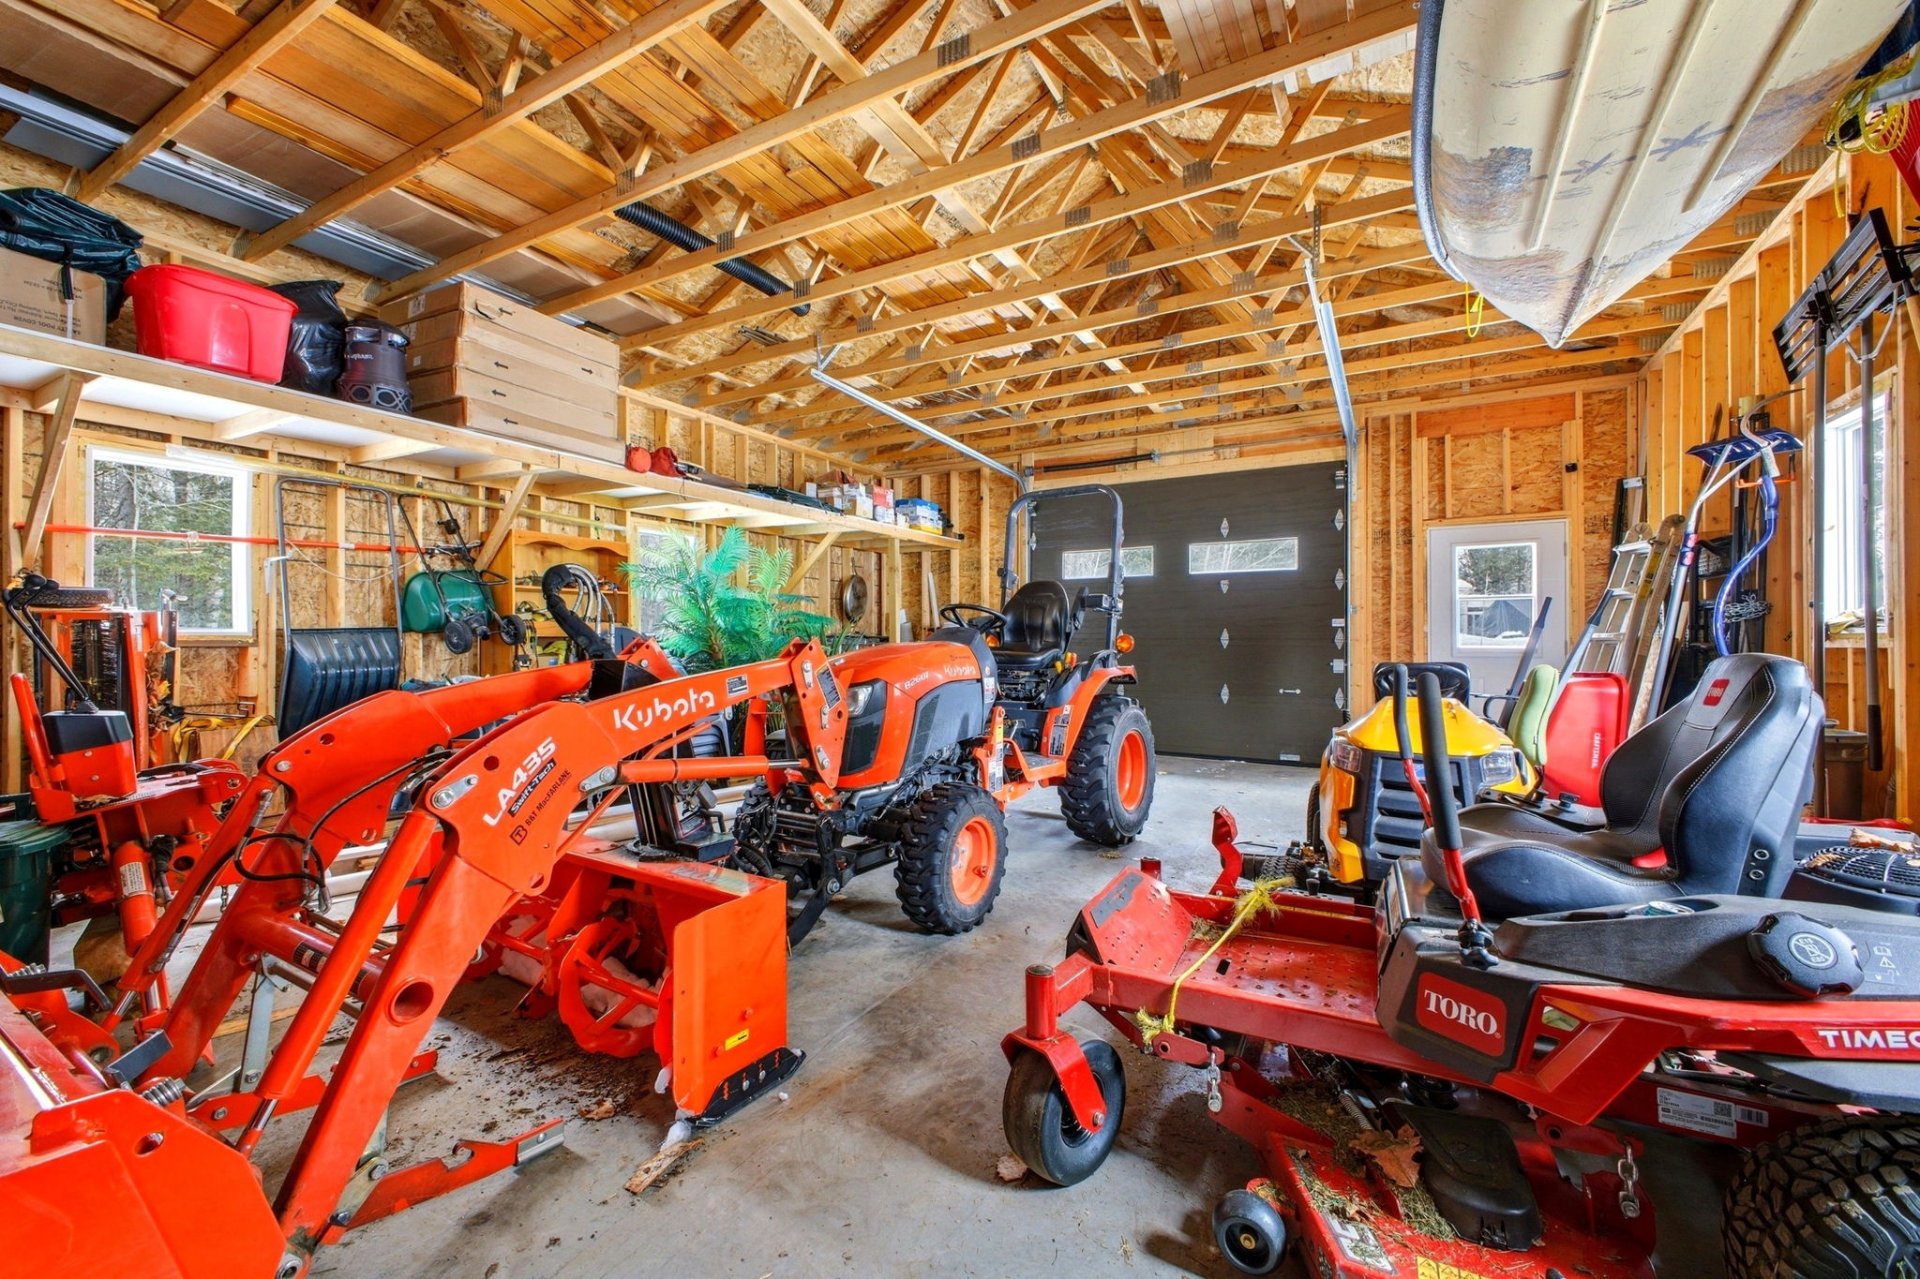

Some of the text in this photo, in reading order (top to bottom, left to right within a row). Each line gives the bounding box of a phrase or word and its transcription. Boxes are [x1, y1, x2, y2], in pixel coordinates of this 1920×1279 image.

[944, 664, 976, 677] Kubota
[613, 688, 715, 731] Kubota
[482, 736, 557, 826] LA435
[510, 760, 555, 815] Swift-Tech
[1424, 989, 1498, 1035] TORO
